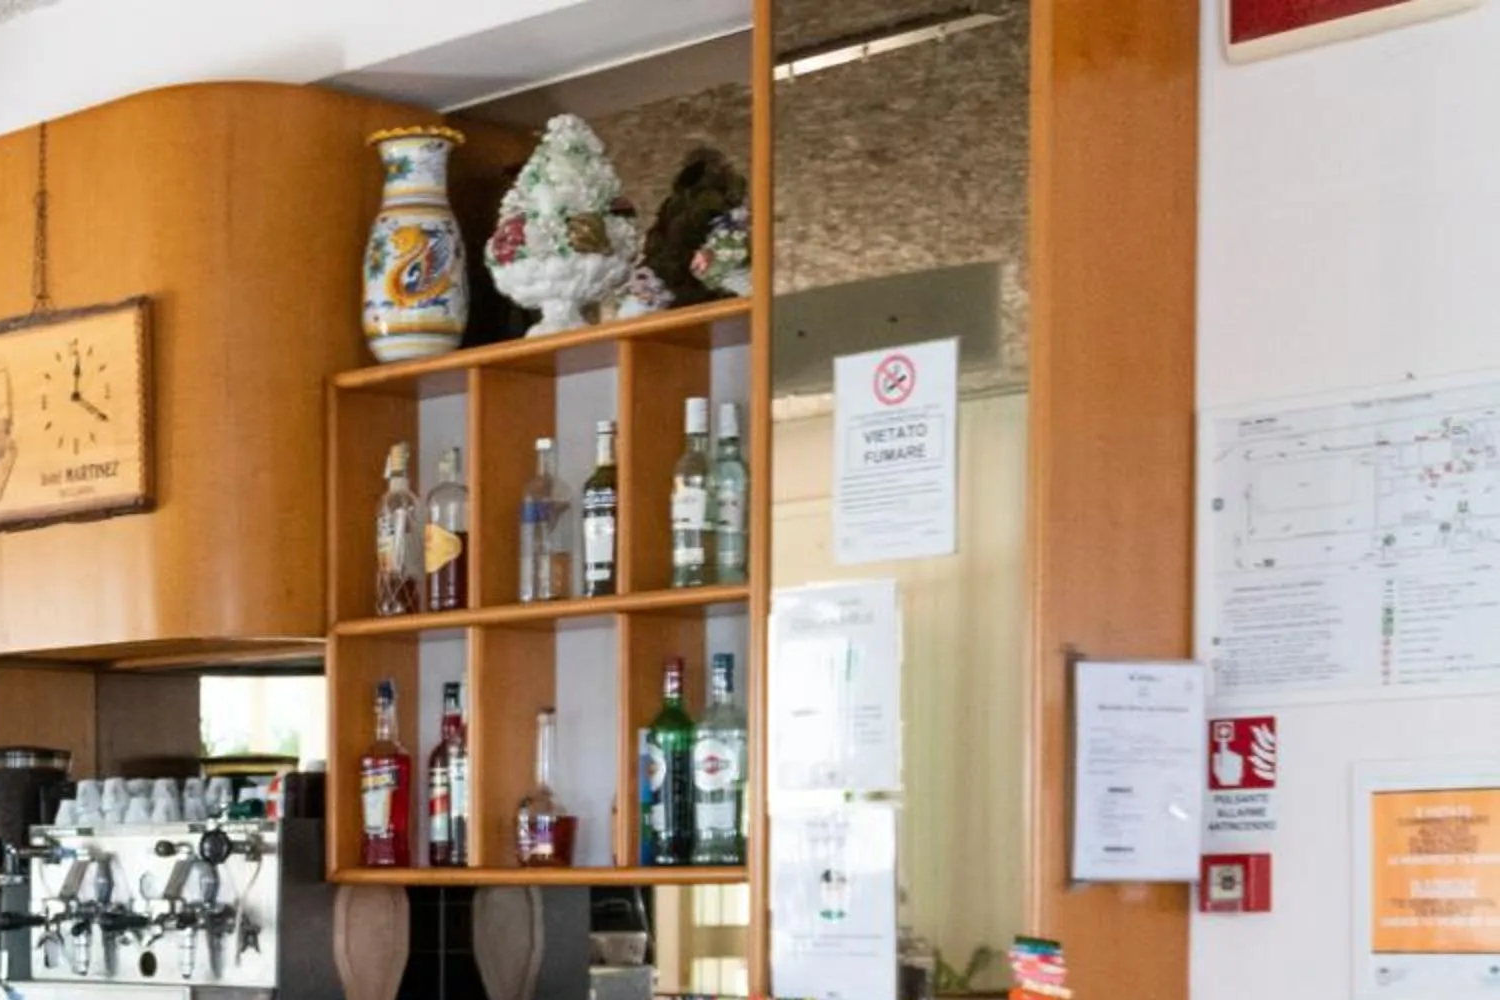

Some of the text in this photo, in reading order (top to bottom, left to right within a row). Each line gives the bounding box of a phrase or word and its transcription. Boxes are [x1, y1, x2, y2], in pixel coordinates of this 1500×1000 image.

[863, 423, 928, 444] VIETATO
[864, 443, 926, 464] FUMARE
[65, 459, 119, 481] MARTINEZ
